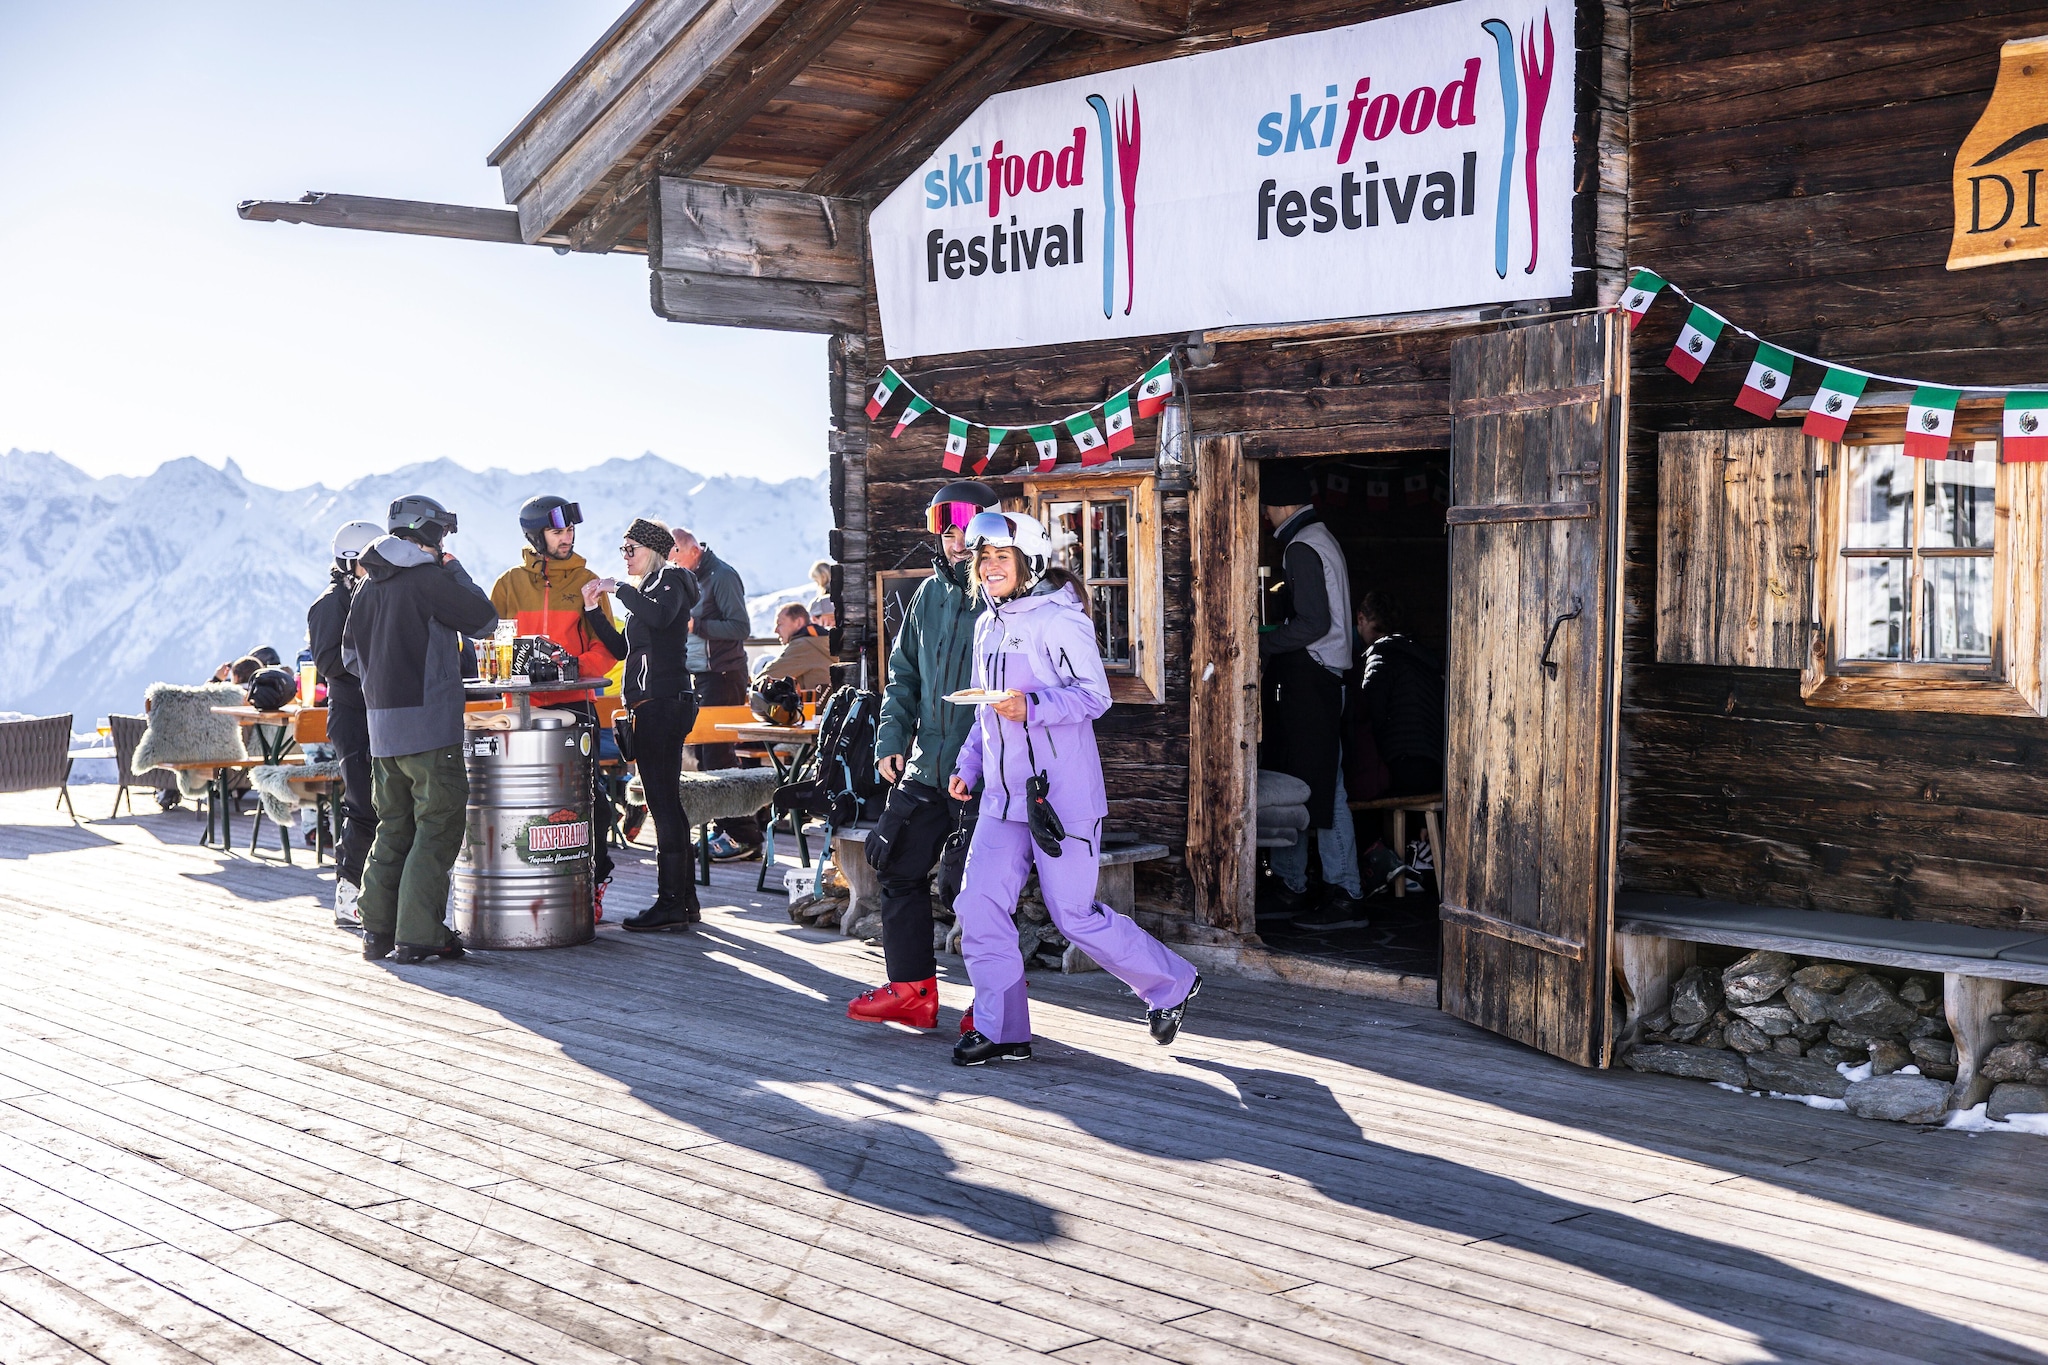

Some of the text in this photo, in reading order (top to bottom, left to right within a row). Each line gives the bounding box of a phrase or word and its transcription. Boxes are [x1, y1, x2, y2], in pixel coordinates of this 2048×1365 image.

[1257, 151, 1477, 241] festival
[927, 208, 1084, 282] festival
[529, 821, 588, 851] DESPERADOS
